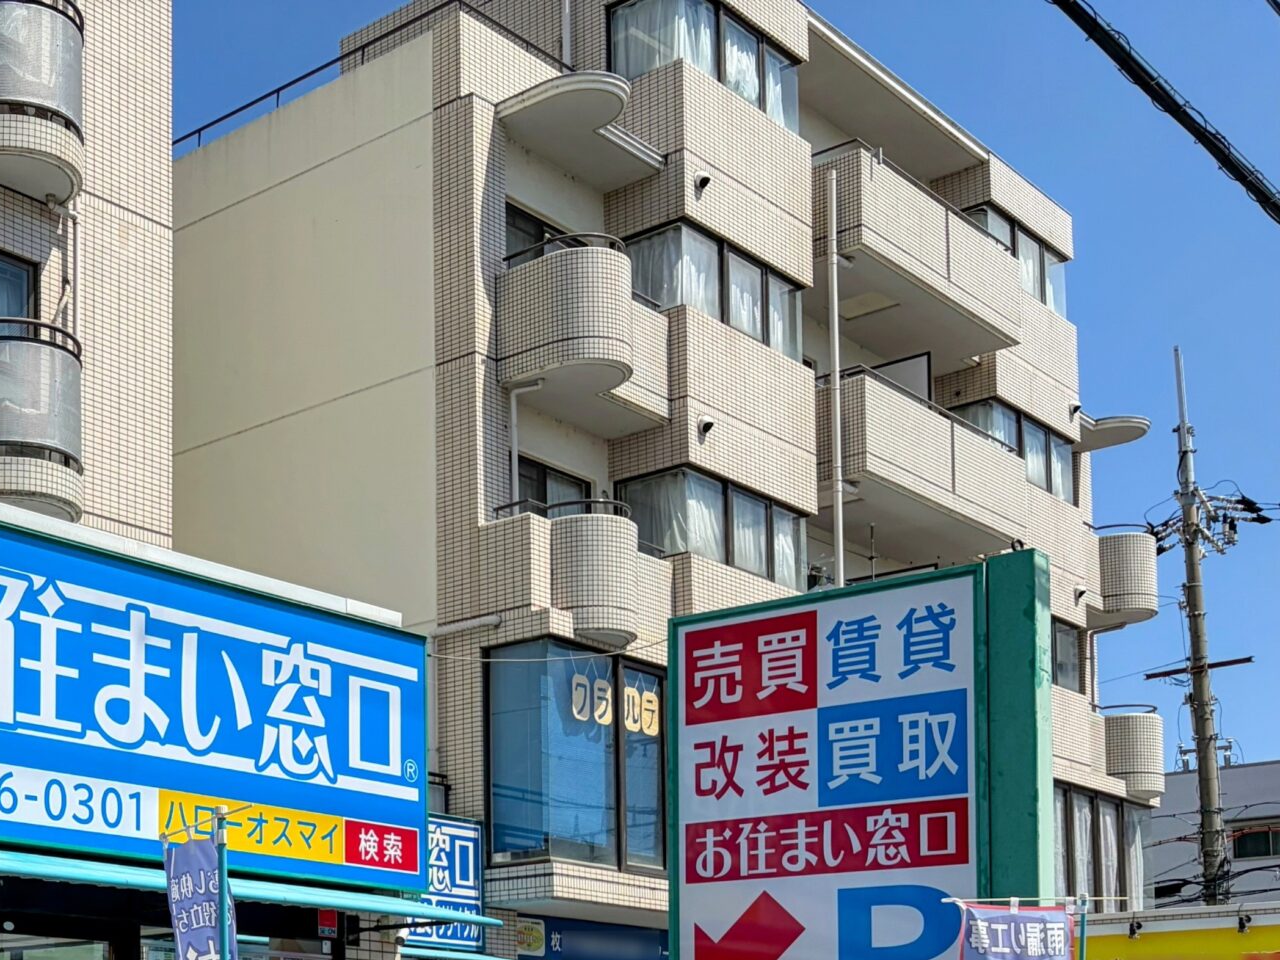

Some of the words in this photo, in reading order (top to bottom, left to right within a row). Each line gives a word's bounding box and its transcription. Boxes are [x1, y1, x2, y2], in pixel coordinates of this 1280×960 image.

[692, 629, 808, 709] 売買
[826, 603, 956, 690] 賃貸
[693, 725, 810, 799] 改装
[828, 711, 959, 790] 買取
[163, 799, 338, 856] ハローオスマイ
[358, 827, 403, 865] 検索
[695, 808, 957, 878] お住まい窓口
